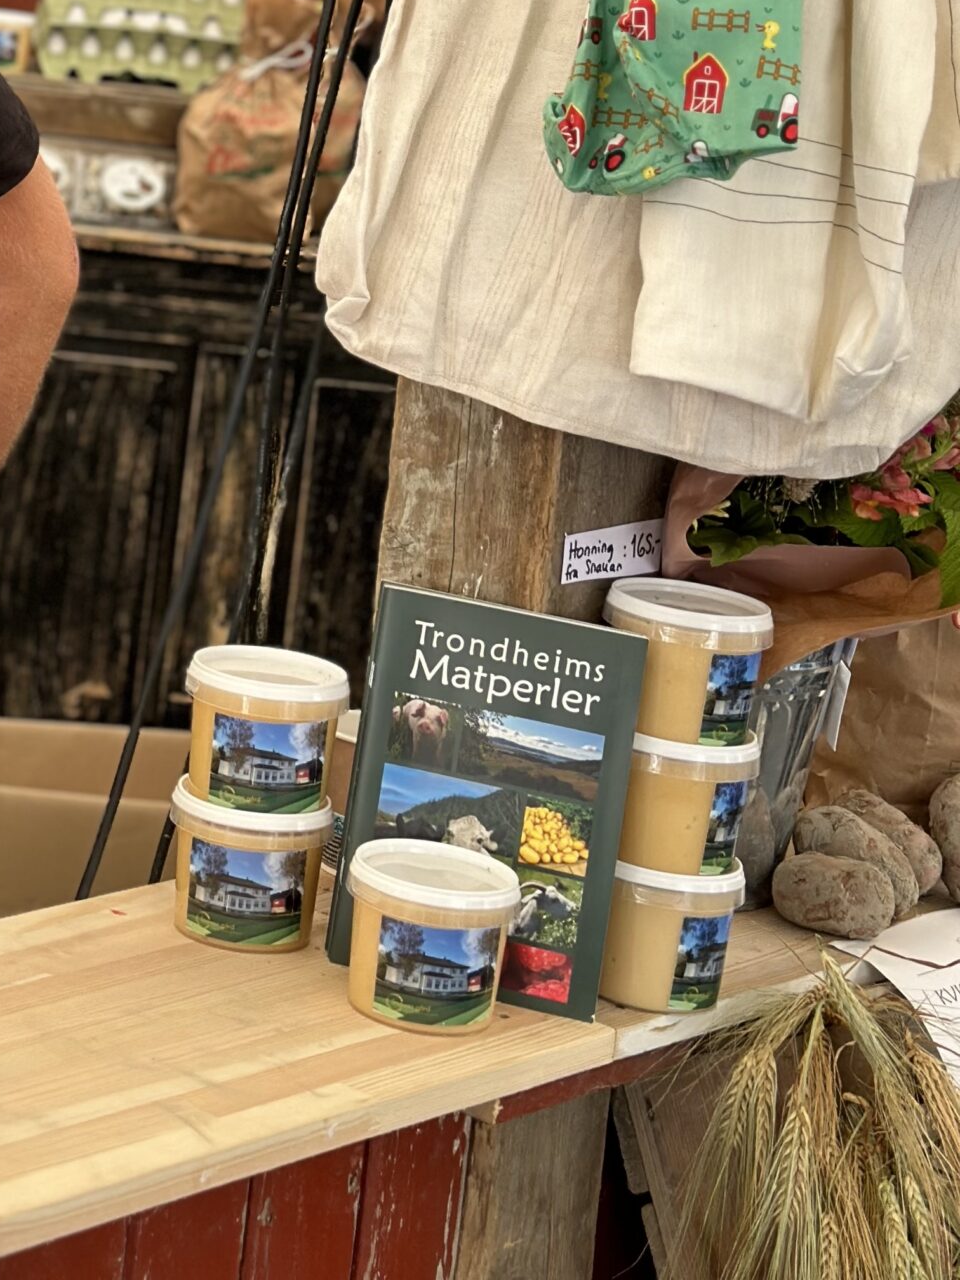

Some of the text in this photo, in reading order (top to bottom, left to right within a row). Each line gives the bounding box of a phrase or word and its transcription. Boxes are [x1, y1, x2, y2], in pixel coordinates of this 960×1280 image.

[565, 563, 578, 581] fra
[568, 539, 614, 564] Honning
[414, 619, 606, 683] Trondheims
[409, 648, 601, 716] Matperler
